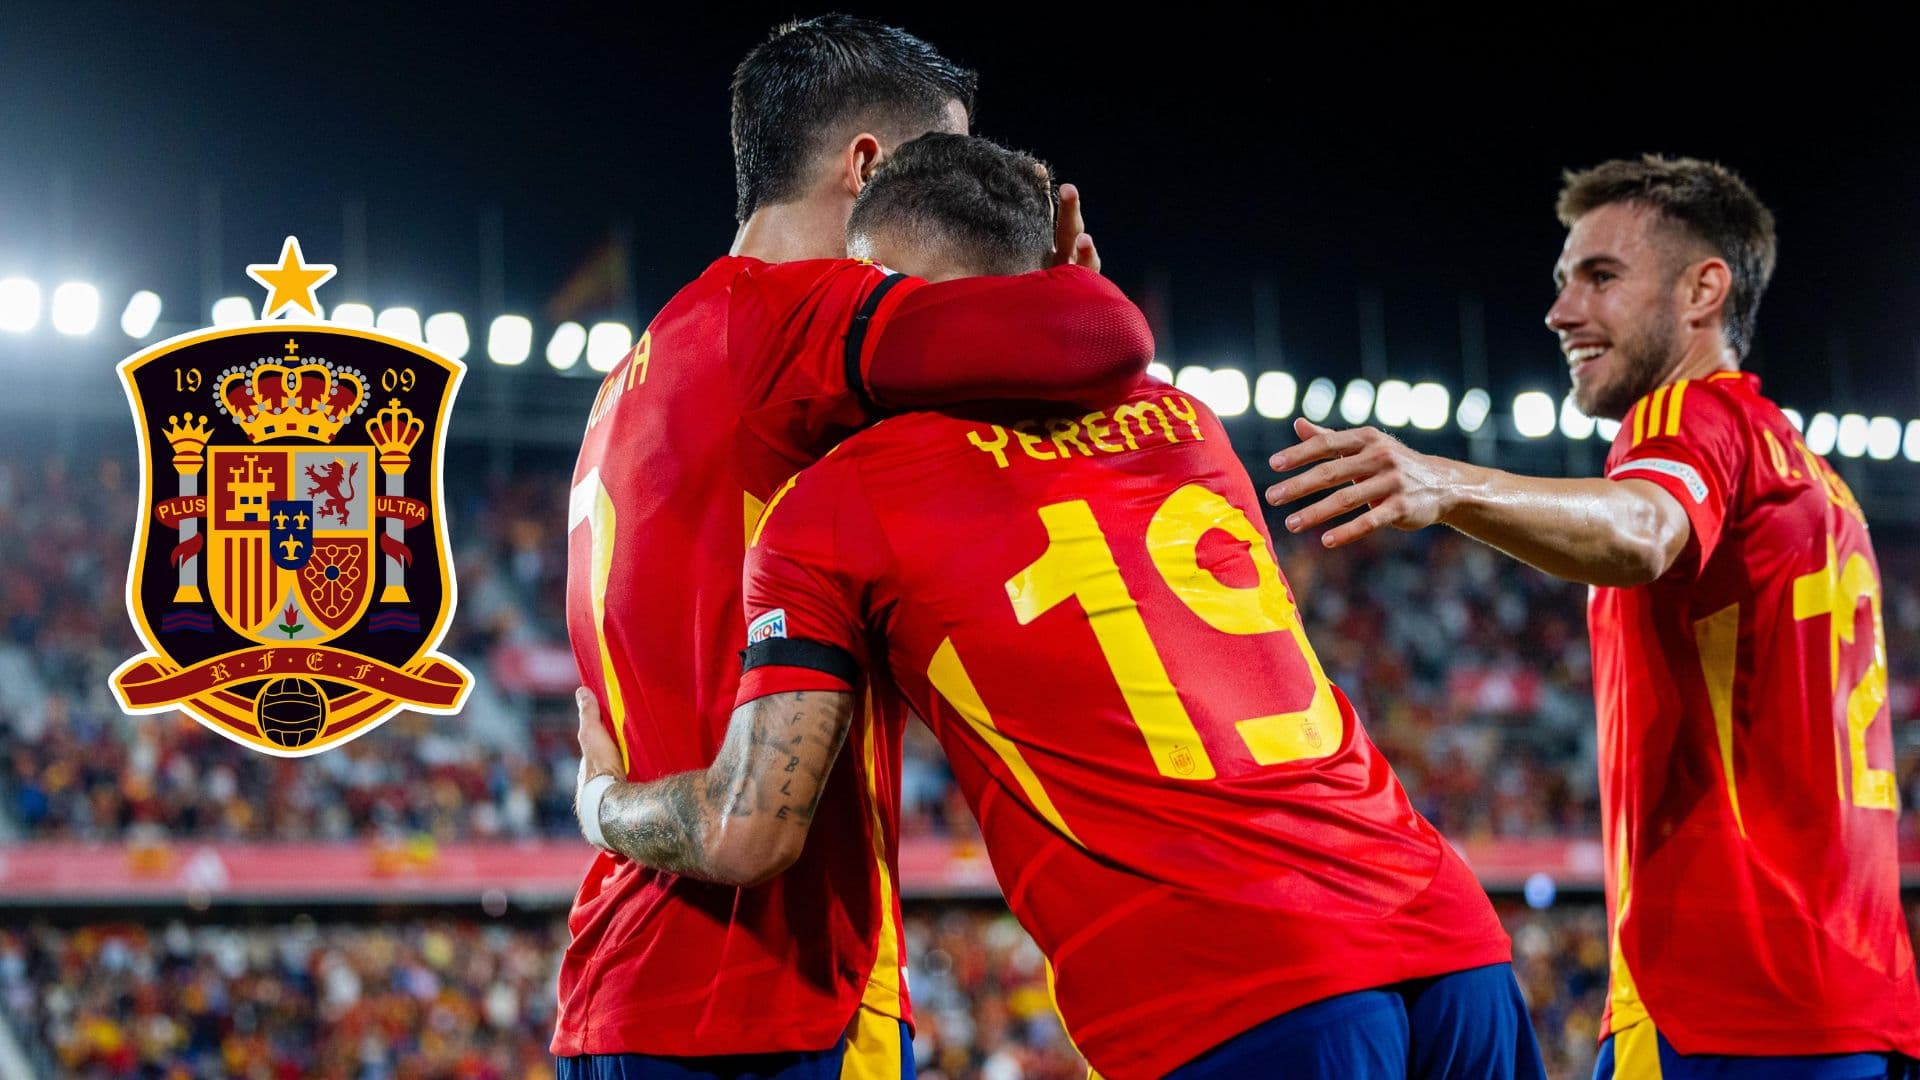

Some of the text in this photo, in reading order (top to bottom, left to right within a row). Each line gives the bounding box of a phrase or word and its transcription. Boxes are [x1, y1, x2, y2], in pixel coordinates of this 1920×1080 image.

[966, 396, 1206, 469] YEREMY
[1004, 483, 1343, 781] 19
[1793, 533, 1898, 812] 12
